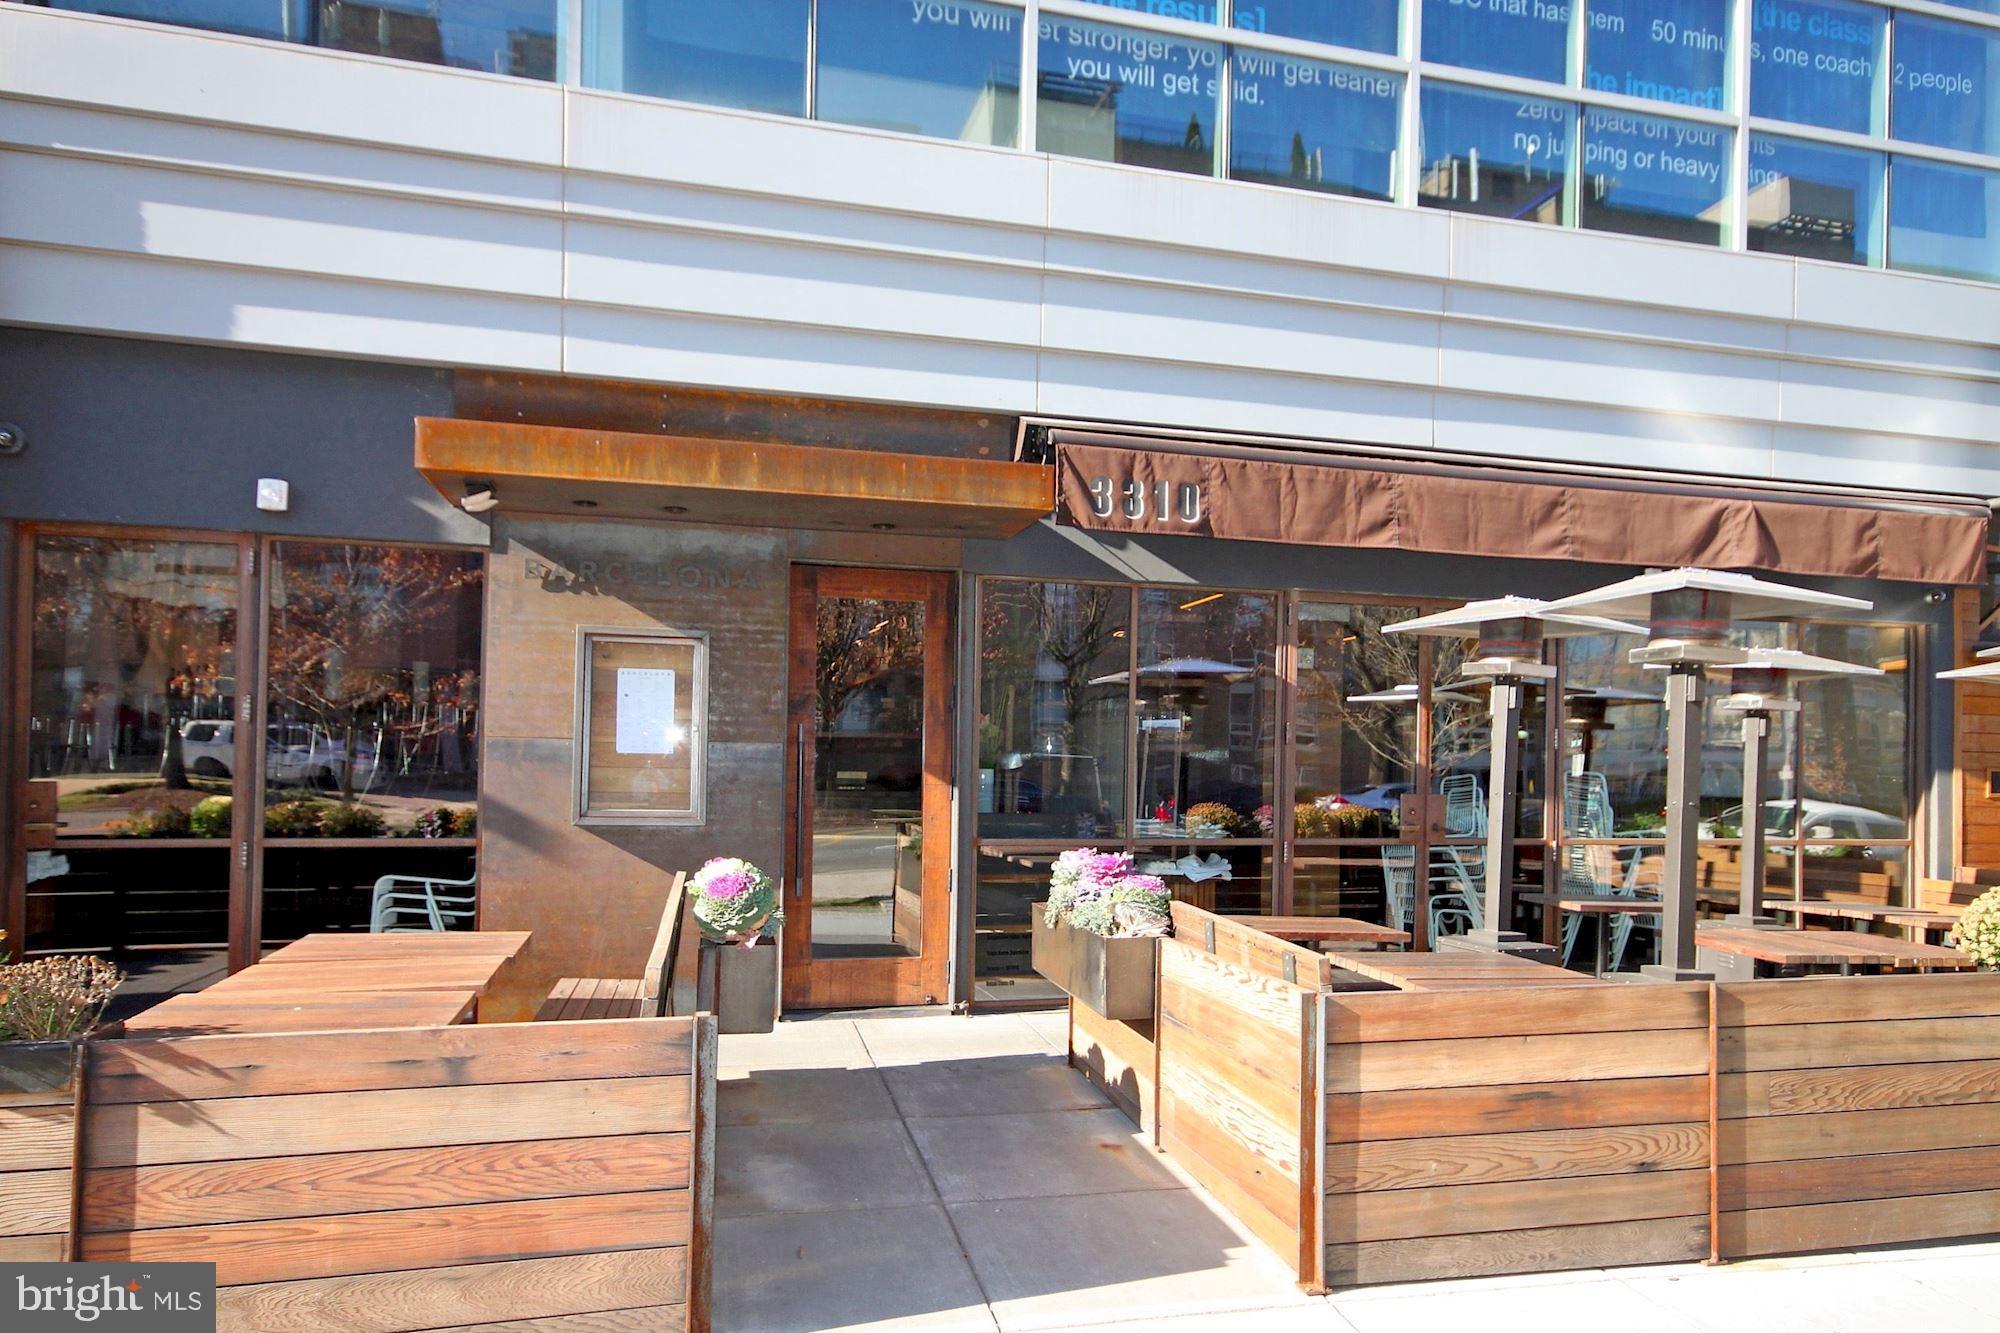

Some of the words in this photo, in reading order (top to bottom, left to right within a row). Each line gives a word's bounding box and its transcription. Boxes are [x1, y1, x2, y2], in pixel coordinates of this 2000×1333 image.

[1534, 2, 1569, 22] has
[912, 1, 960, 25] you
[969, 10, 1010, 32] will
[1038, 21, 1060, 42] et
[1068, 26, 1177, 62] stronger.
[1188, 47, 1215, 70] yo
[1239, 55, 1275, 77] will
[1284, 61, 1320, 86] get
[1652, 18, 1676, 44] 50
[1772, 46, 1809, 66] one
[1815, 54, 1872, 78] coach
[1909, 69, 1973, 95] people
[1067, 56, 1111, 80] you
[1119, 63, 1155, 87] will
[1163, 72, 1199, 97] get
[1206, 79, 1265, 106] slid.
[1516, 102, 1563, 123] zero
[1643, 120, 1668, 140] on
[1675, 125, 1717, 148] your
[1514, 132, 1541, 152] no
[1545, 131, 1628, 171] juping
[1634, 151, 1655, 169] or
[1661, 149, 1720, 184] heavy
[1091, 475, 1201, 524] 3310
[524, 558, 761, 589] BARCELONA
